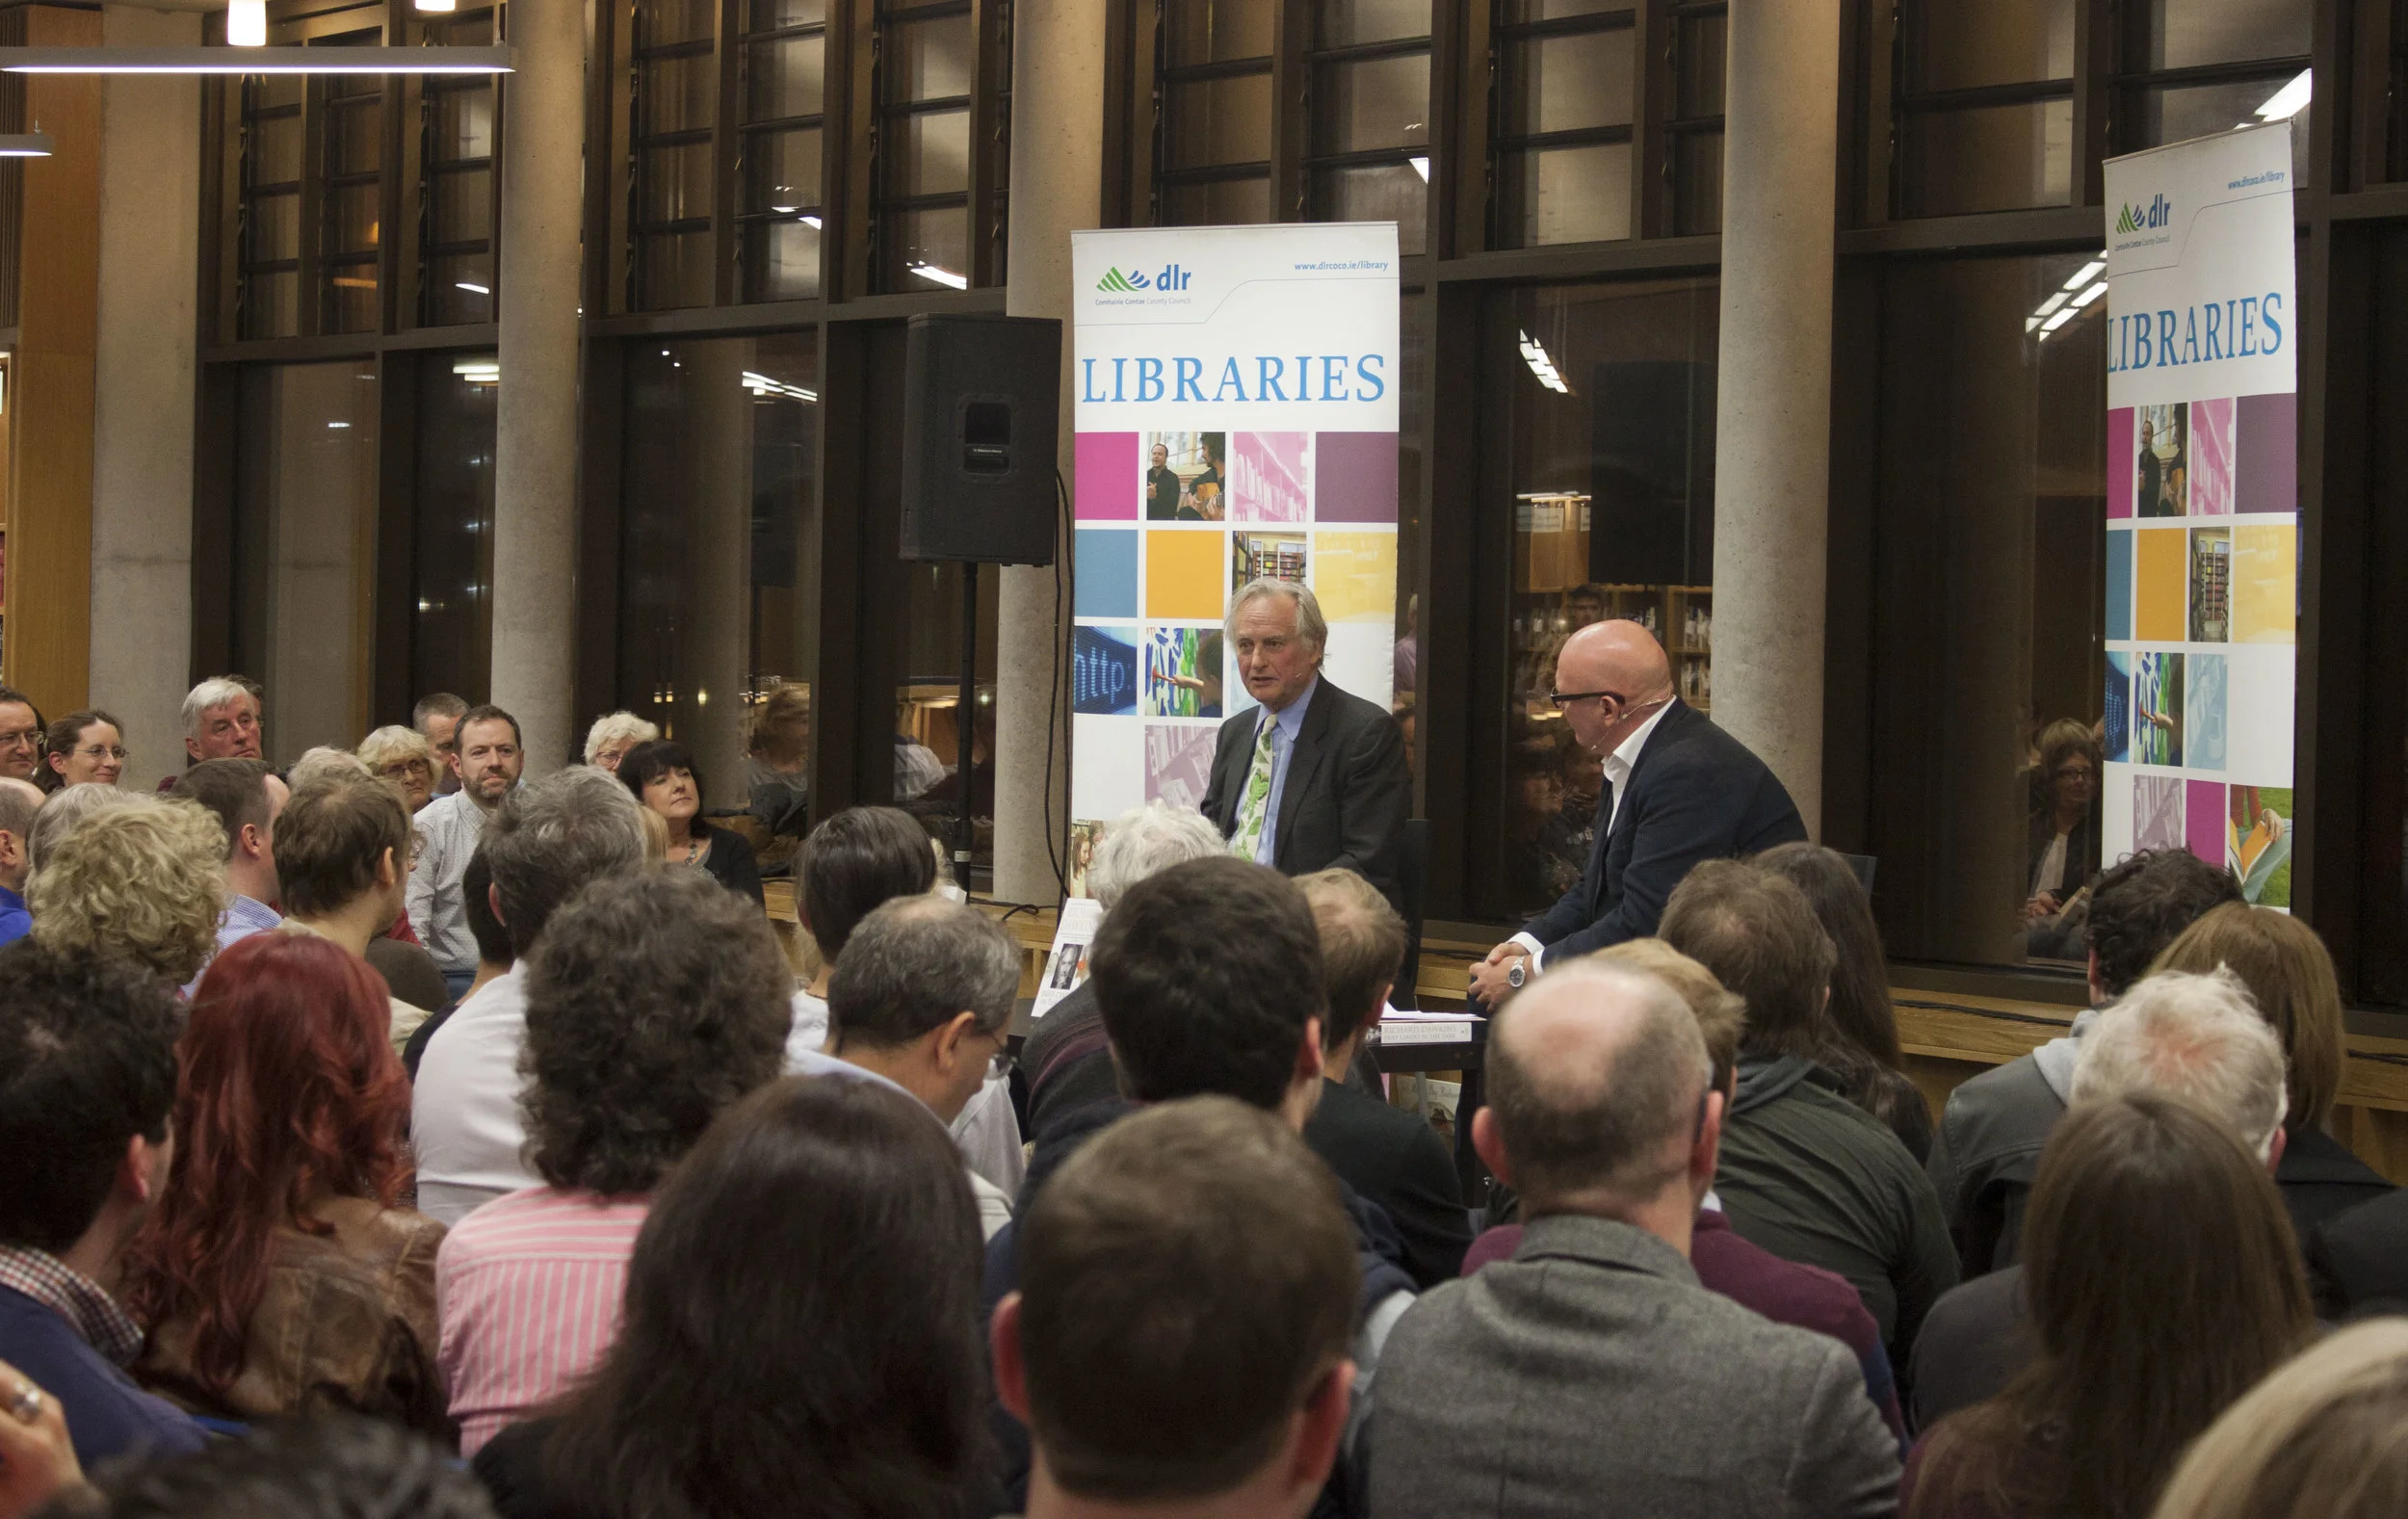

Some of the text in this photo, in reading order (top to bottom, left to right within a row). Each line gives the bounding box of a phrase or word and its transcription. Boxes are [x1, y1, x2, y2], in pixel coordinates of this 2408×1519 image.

[2148, 193, 2171, 229] dlr
[1156, 263, 1191, 292] dlr
[1294, 260, 1389, 272] www.dlrcoco.ie/library
[1147, 298, 1167, 306] County
[2107, 292, 2282, 374] LIBRARIES
[1082, 354, 1385, 403] LIBRARIES
